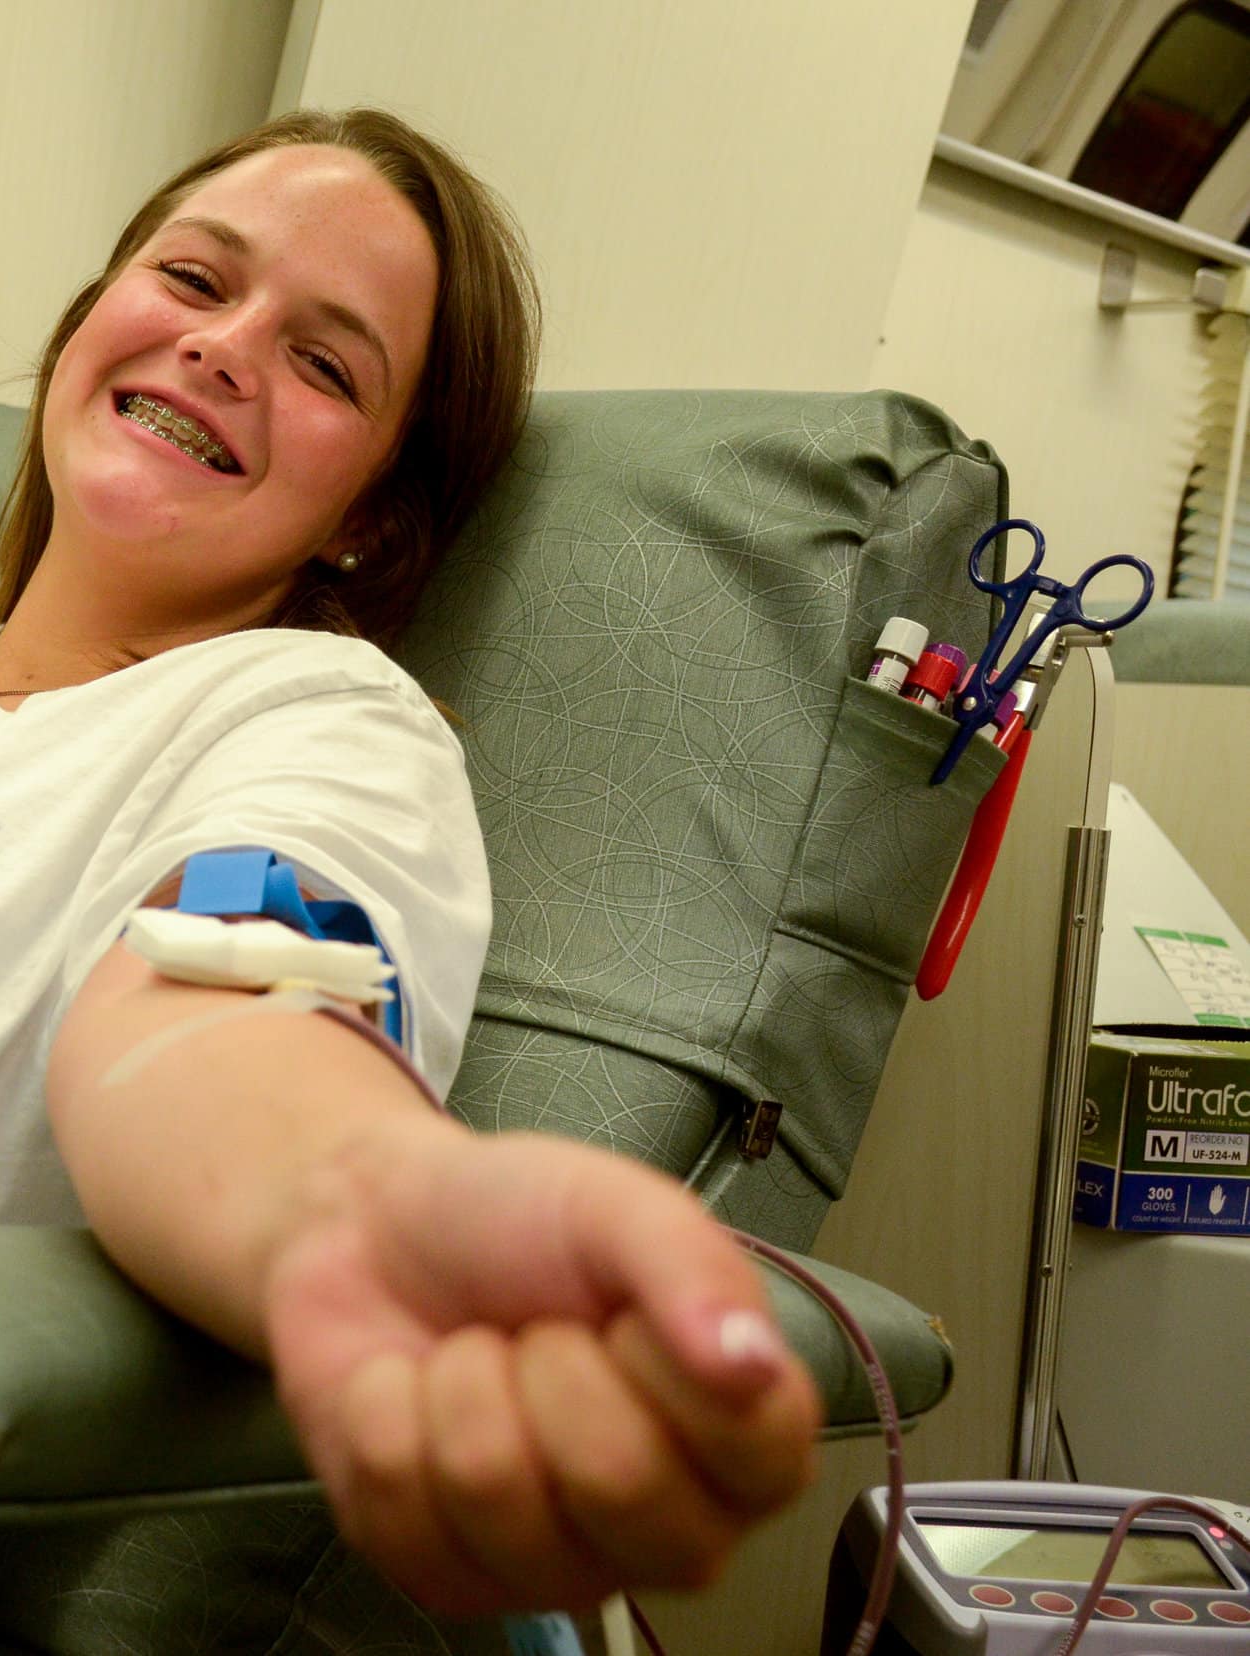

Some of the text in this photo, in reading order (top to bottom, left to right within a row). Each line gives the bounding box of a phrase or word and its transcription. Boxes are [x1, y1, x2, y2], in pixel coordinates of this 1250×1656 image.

[1149, 1065, 1190, 1078] Microflex
[1190, 1134, 1226, 1145] REORDER
[1150, 1135, 1179, 1159] M
[1192, 1149, 1241, 1161] UF-524-M
[1147, 1187, 1174, 1201] 300
[1141, 1201, 1177, 1212] GLOVES
